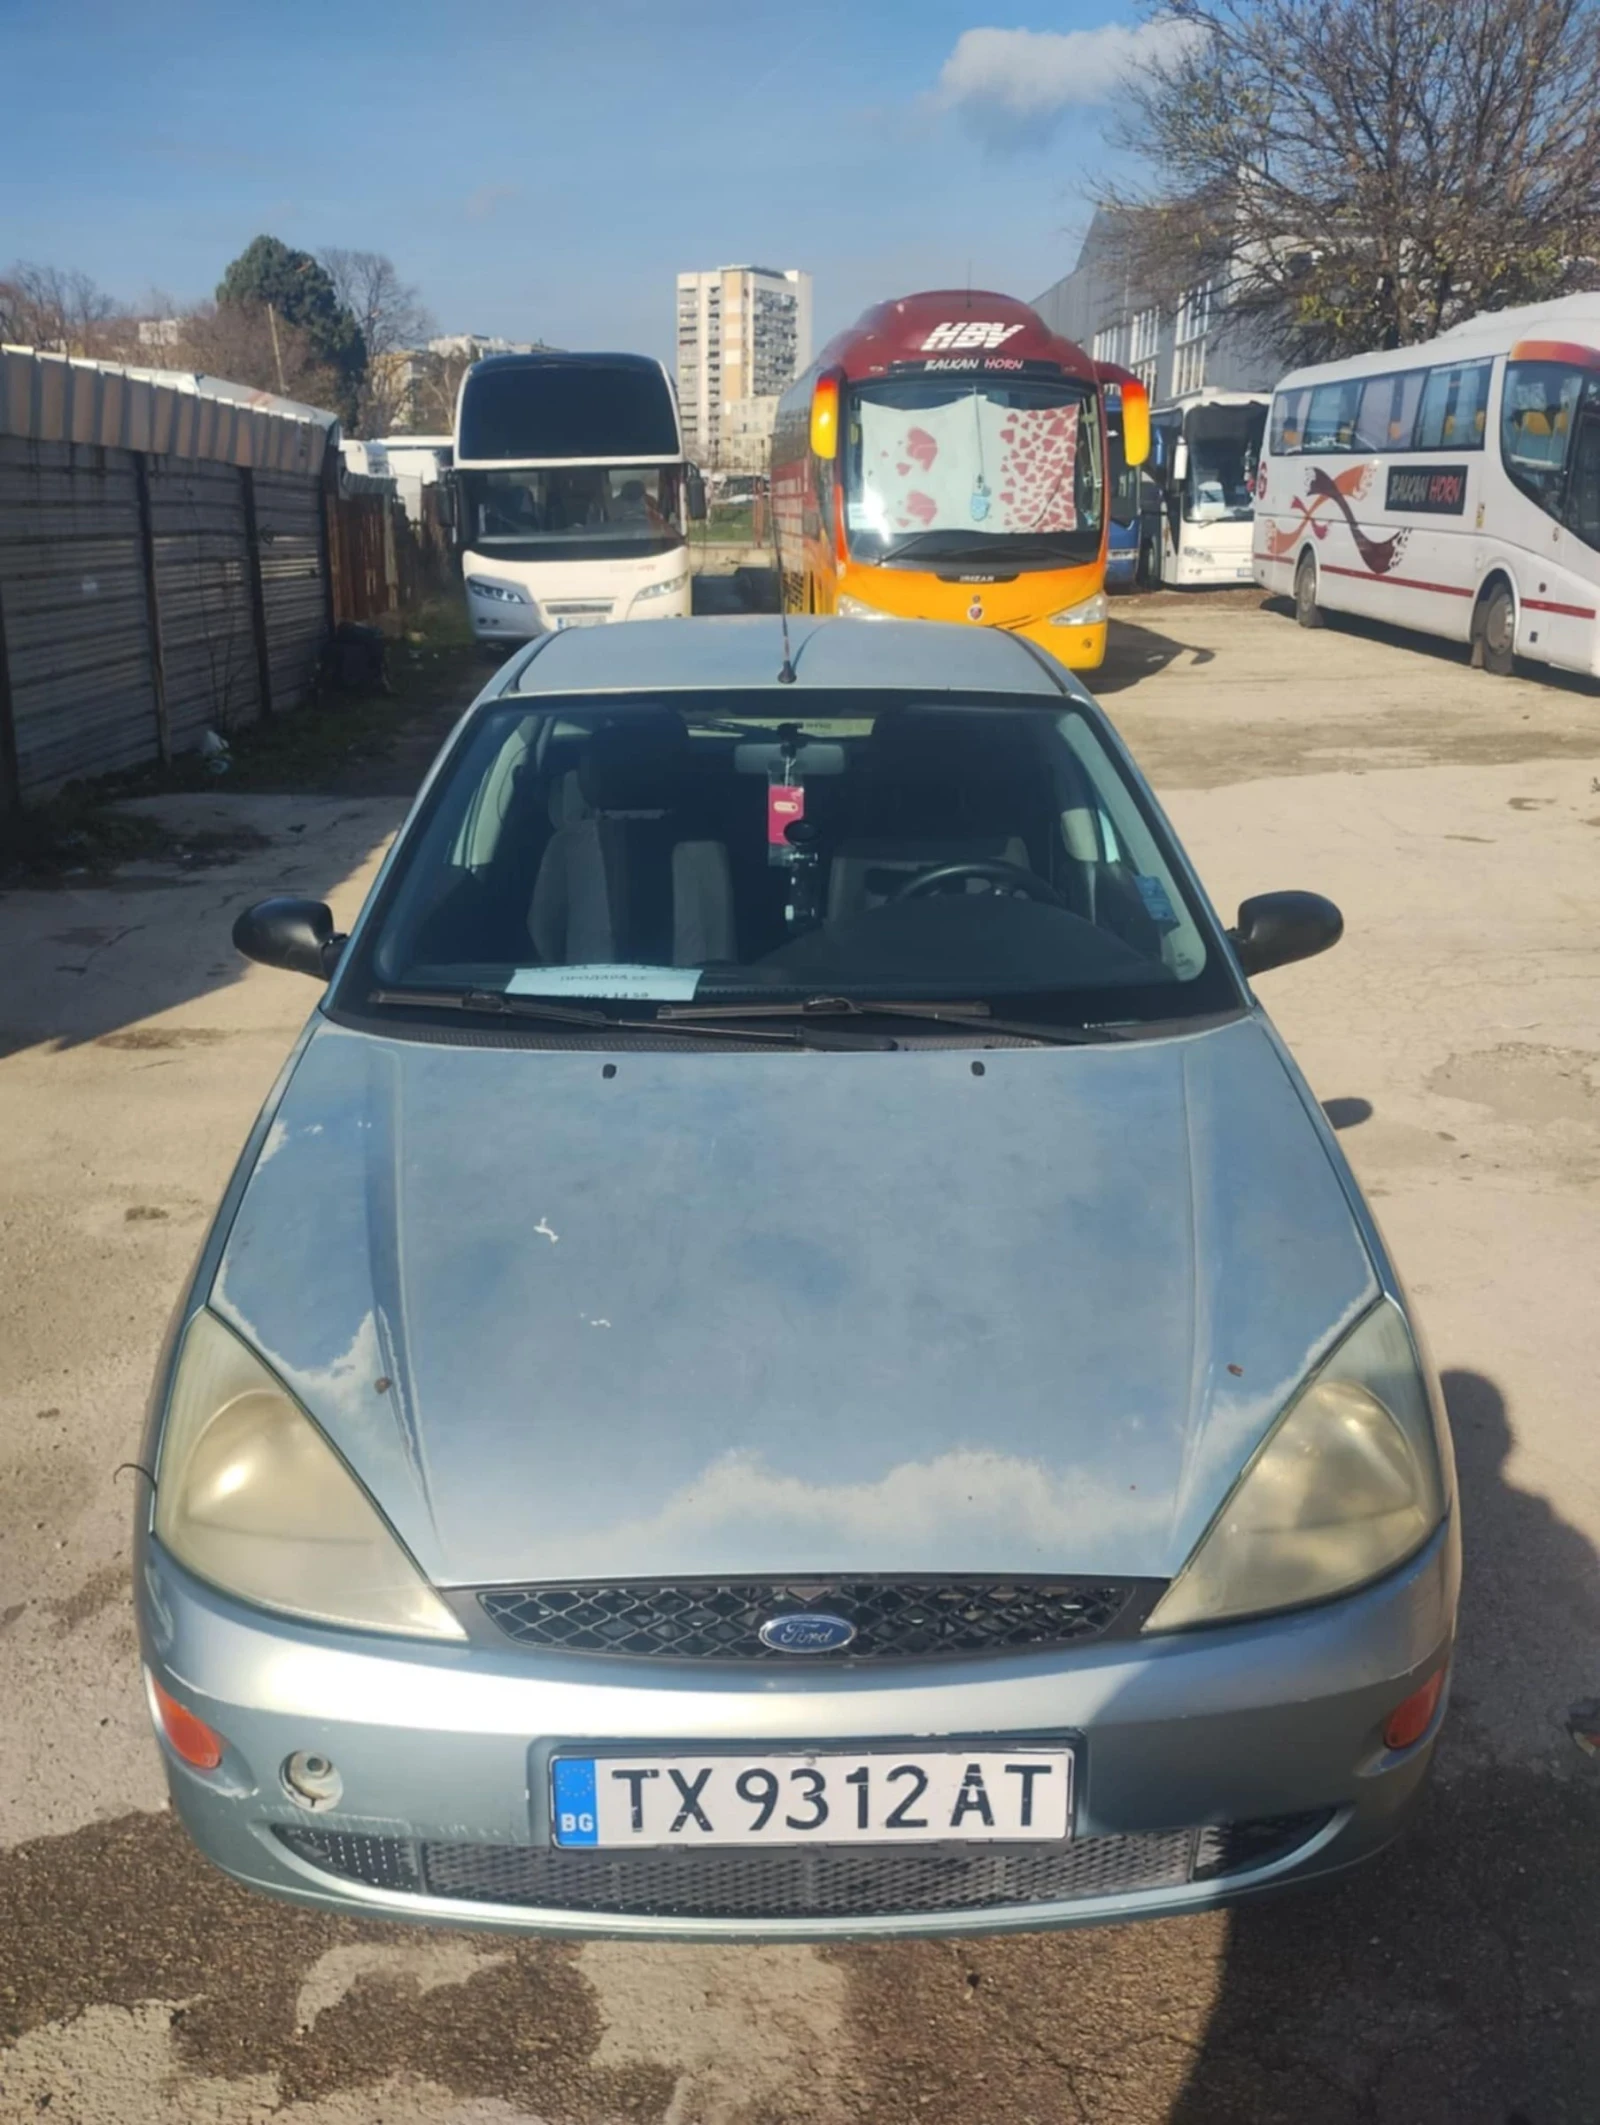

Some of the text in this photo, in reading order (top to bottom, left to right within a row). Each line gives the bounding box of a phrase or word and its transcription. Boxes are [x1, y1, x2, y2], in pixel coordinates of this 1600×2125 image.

[924, 358, 1024, 371] BALKAN HORN
[1429, 475, 1462, 504] HORN
[781, 1622, 834, 1644] Ford
[611, 1763, 1053, 1832] TX 9312 AT
[561, 1813, 594, 1833] BG
